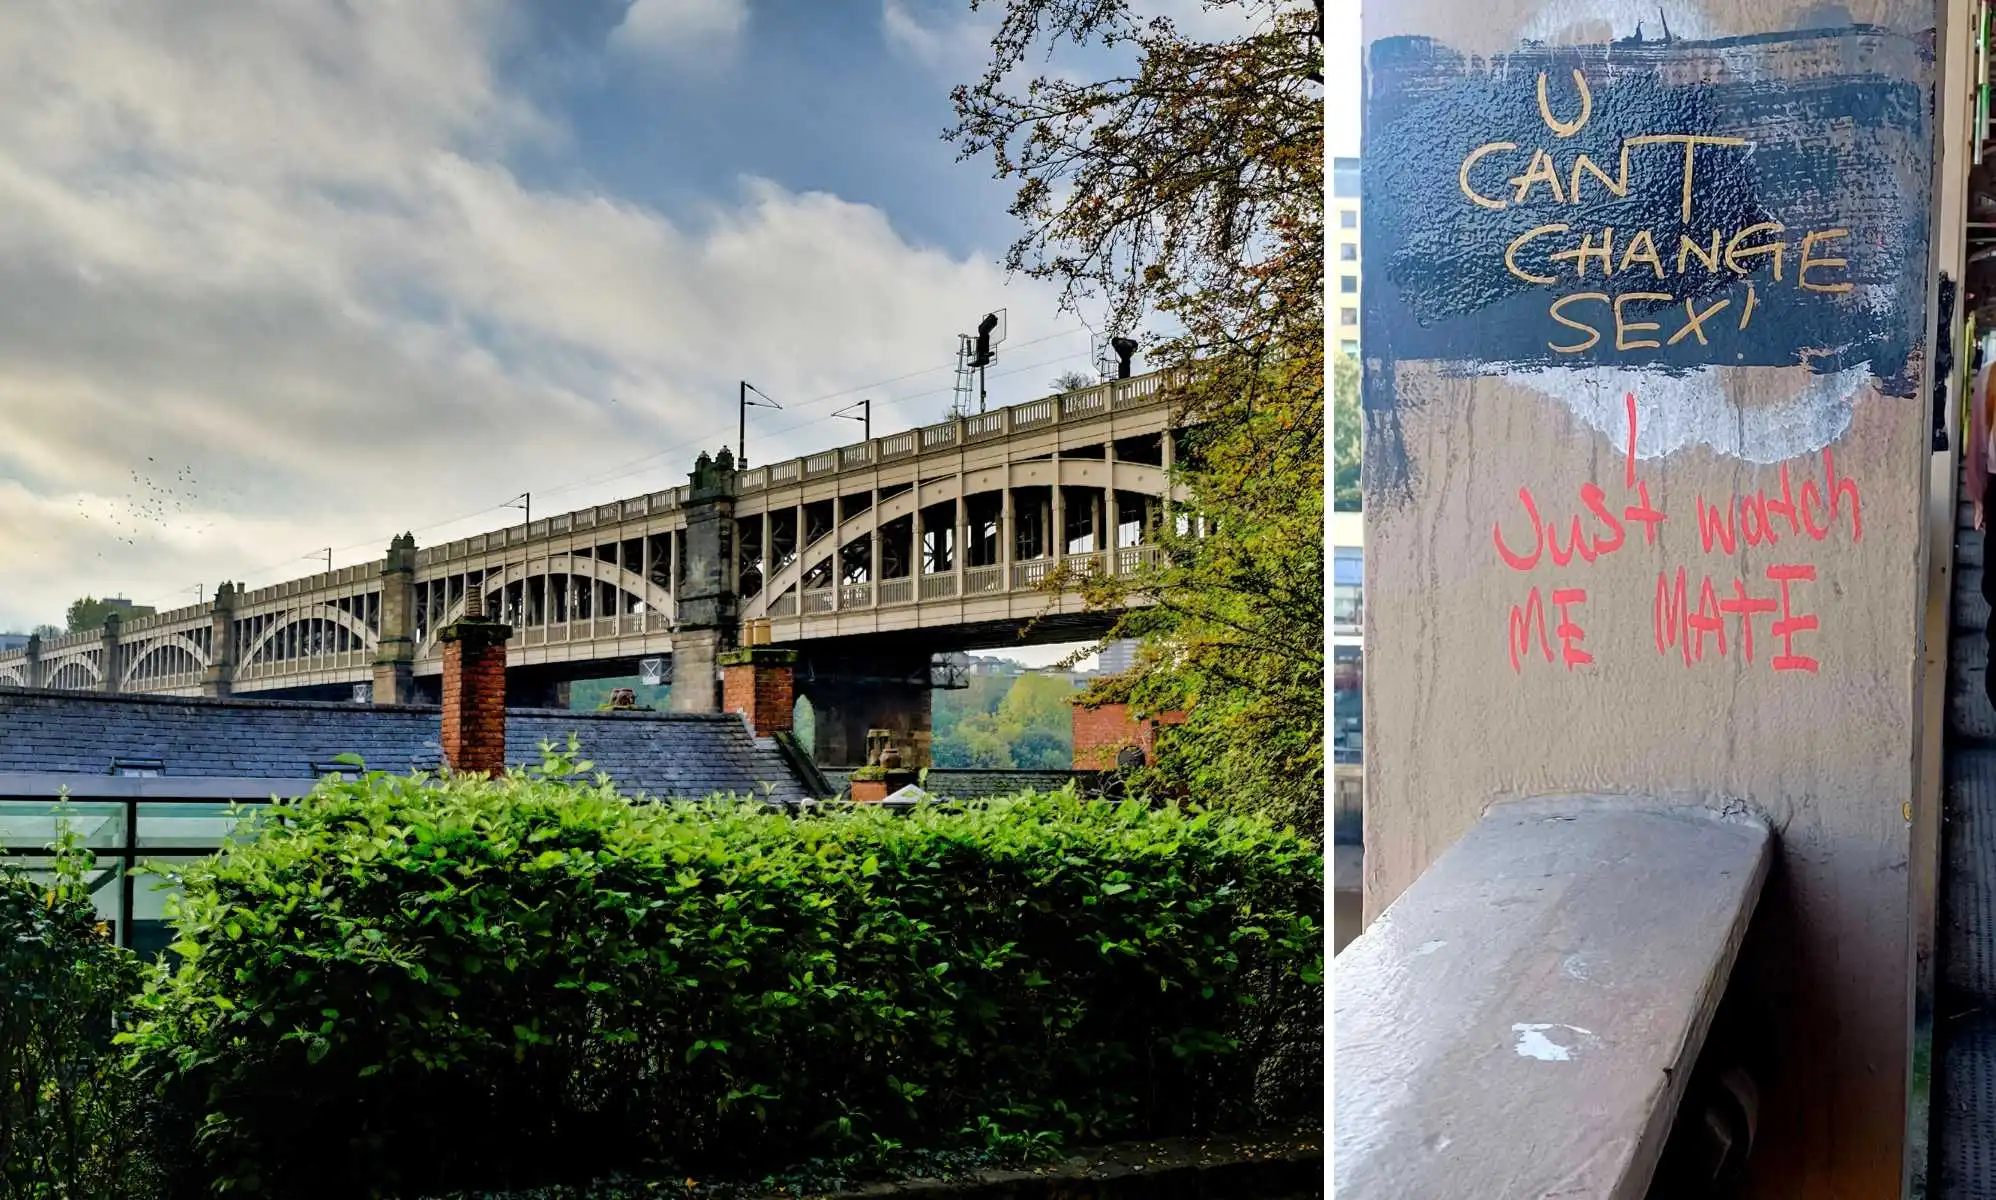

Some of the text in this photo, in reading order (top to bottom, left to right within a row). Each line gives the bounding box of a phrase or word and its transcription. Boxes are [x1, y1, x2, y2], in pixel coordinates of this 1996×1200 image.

[1537, 69, 1592, 138] U
[1505, 223, 1855, 293] CHANGE
[1548, 287, 1757, 360] SEX!
[1696, 445, 1863, 556] watch
[1509, 564, 1819, 675] ME MATE
